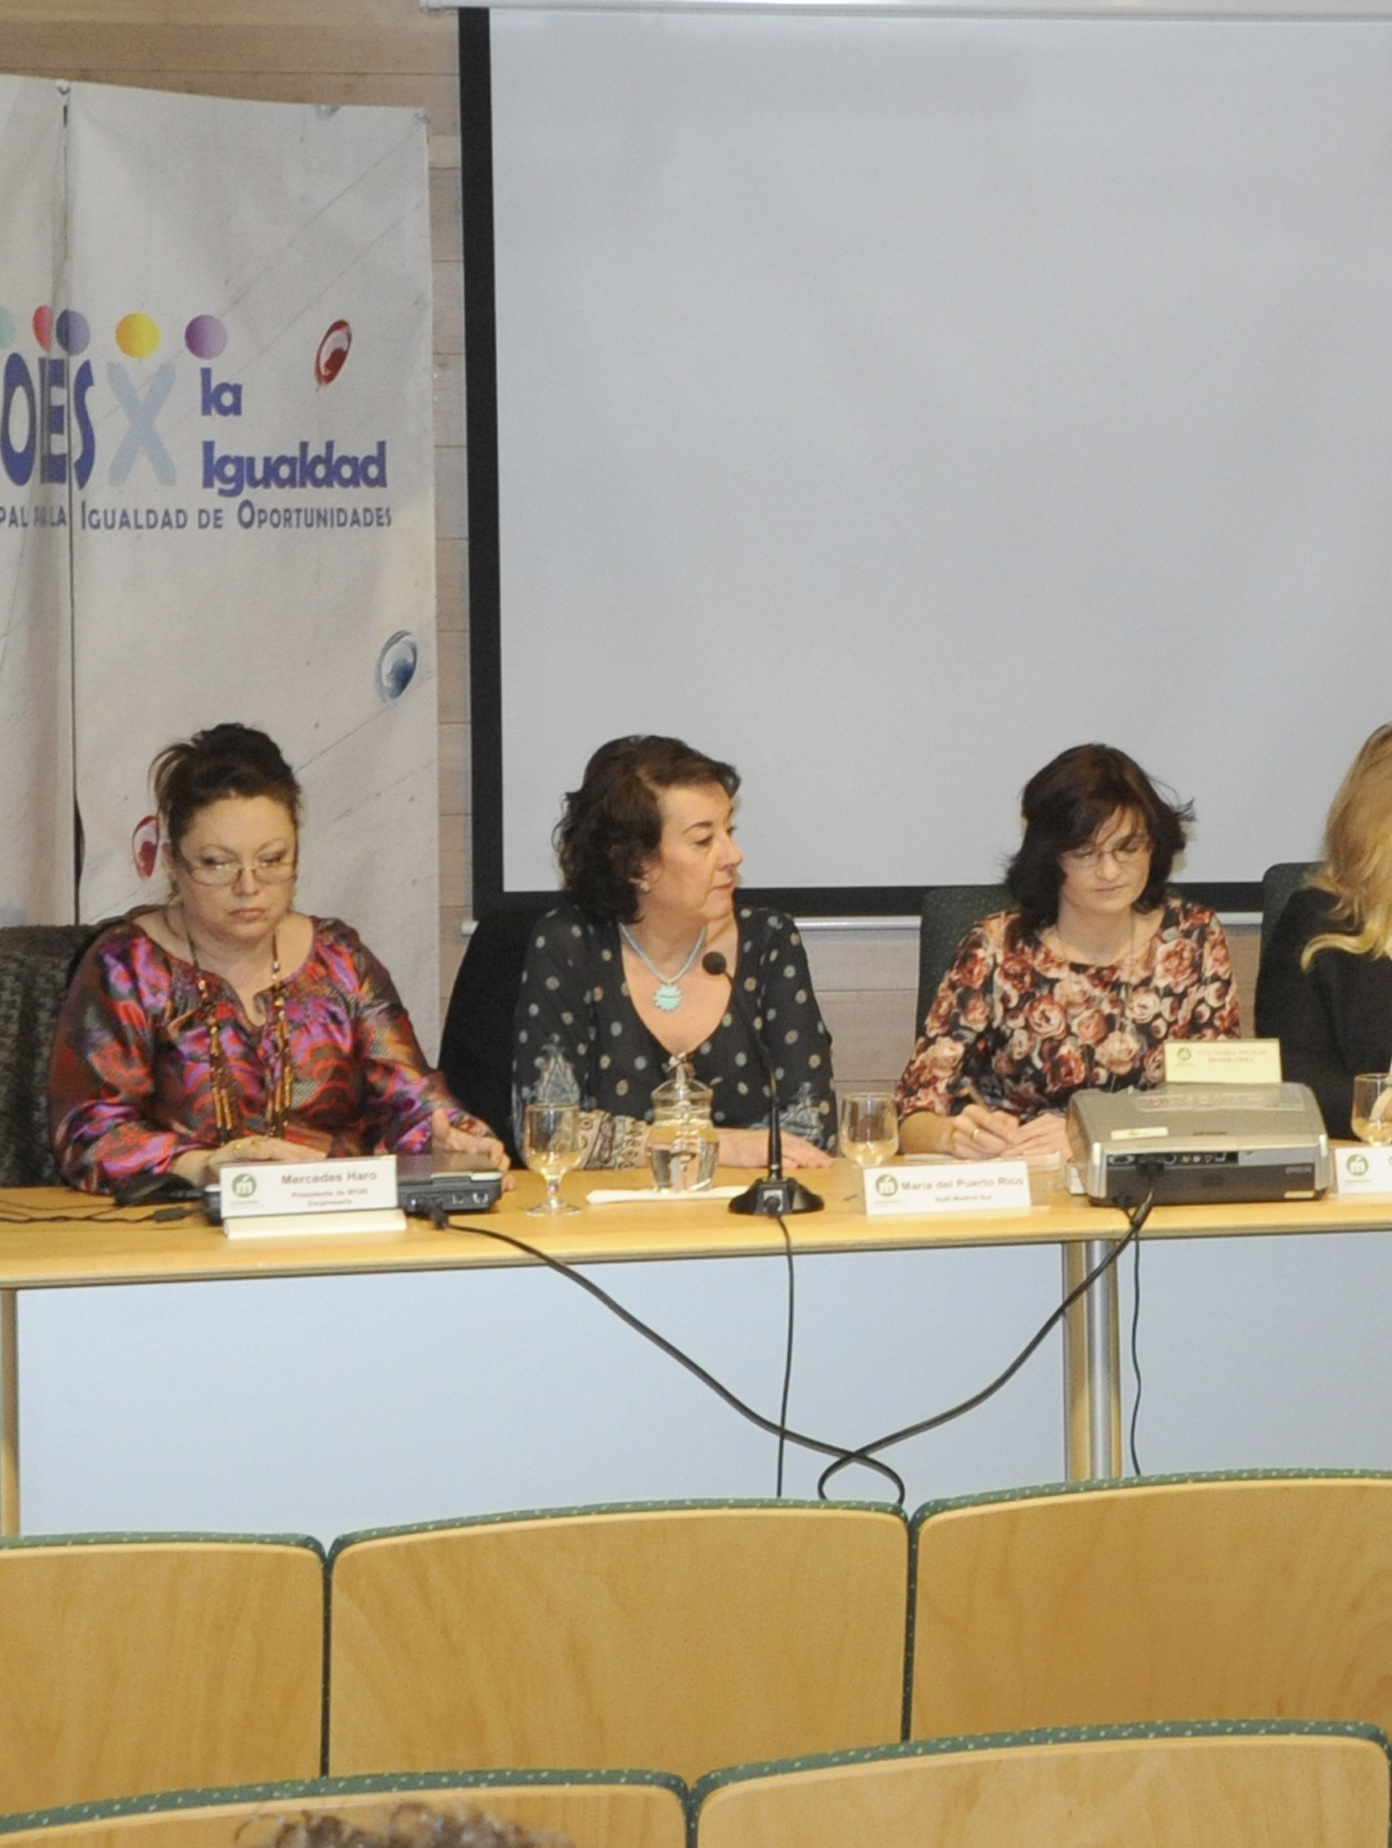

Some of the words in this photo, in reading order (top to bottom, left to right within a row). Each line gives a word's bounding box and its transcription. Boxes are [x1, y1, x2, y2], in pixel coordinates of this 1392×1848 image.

[200, 367, 243, 417] la
[106, 362, 178, 487] X
[202, 440, 388, 498] Igualdad
[199, 507, 223, 530] DE
[282, 1173, 342, 1185] Mercedes
[346, 1170, 377, 1182] Haro
[956, 1178, 994, 1189] Puerto
[997, 1176, 1023, 1187] Rico
